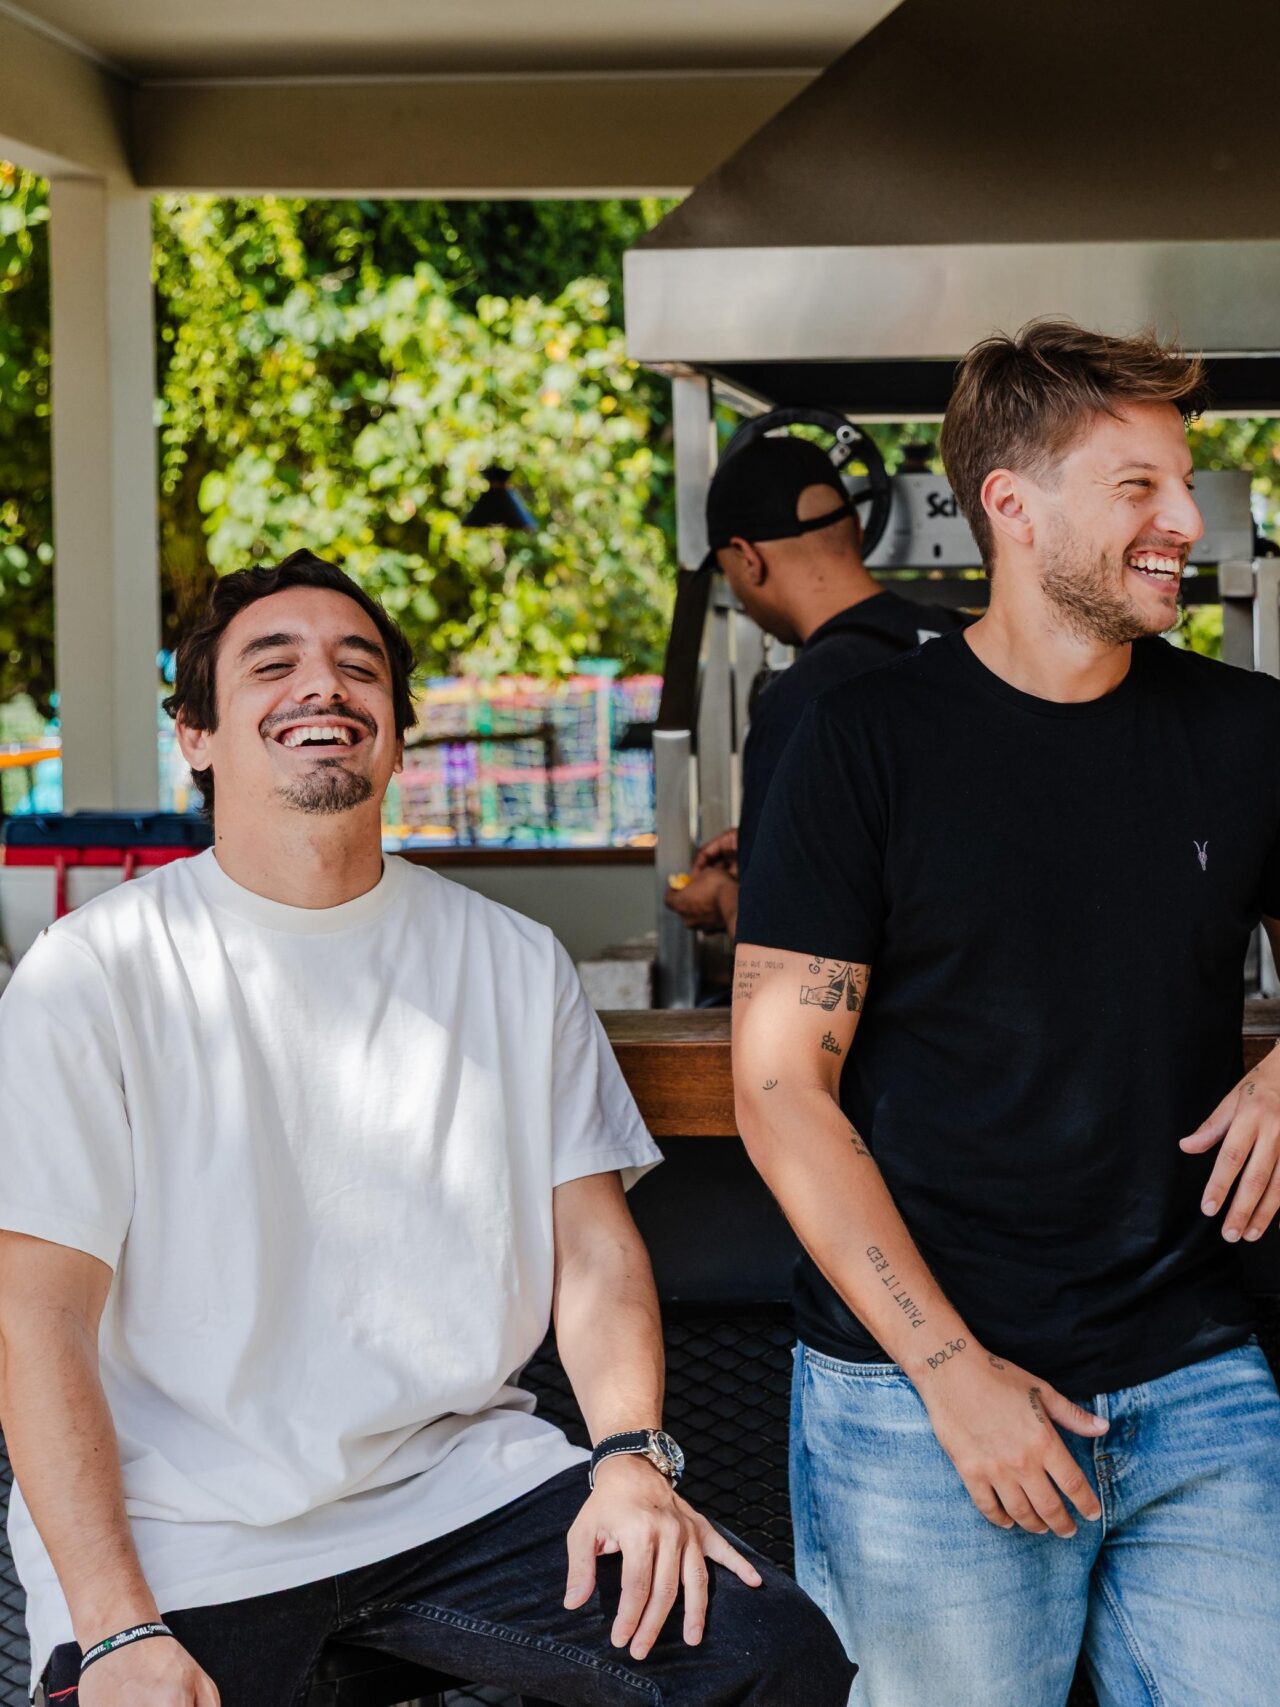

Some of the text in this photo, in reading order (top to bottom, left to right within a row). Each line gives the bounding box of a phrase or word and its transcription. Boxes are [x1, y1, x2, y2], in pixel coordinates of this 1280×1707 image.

[823, 1031, 836, 1045] do
[866, 1245, 926, 1328] PAINT IT RED
[926, 1338, 967, 1370] BOLÃO
